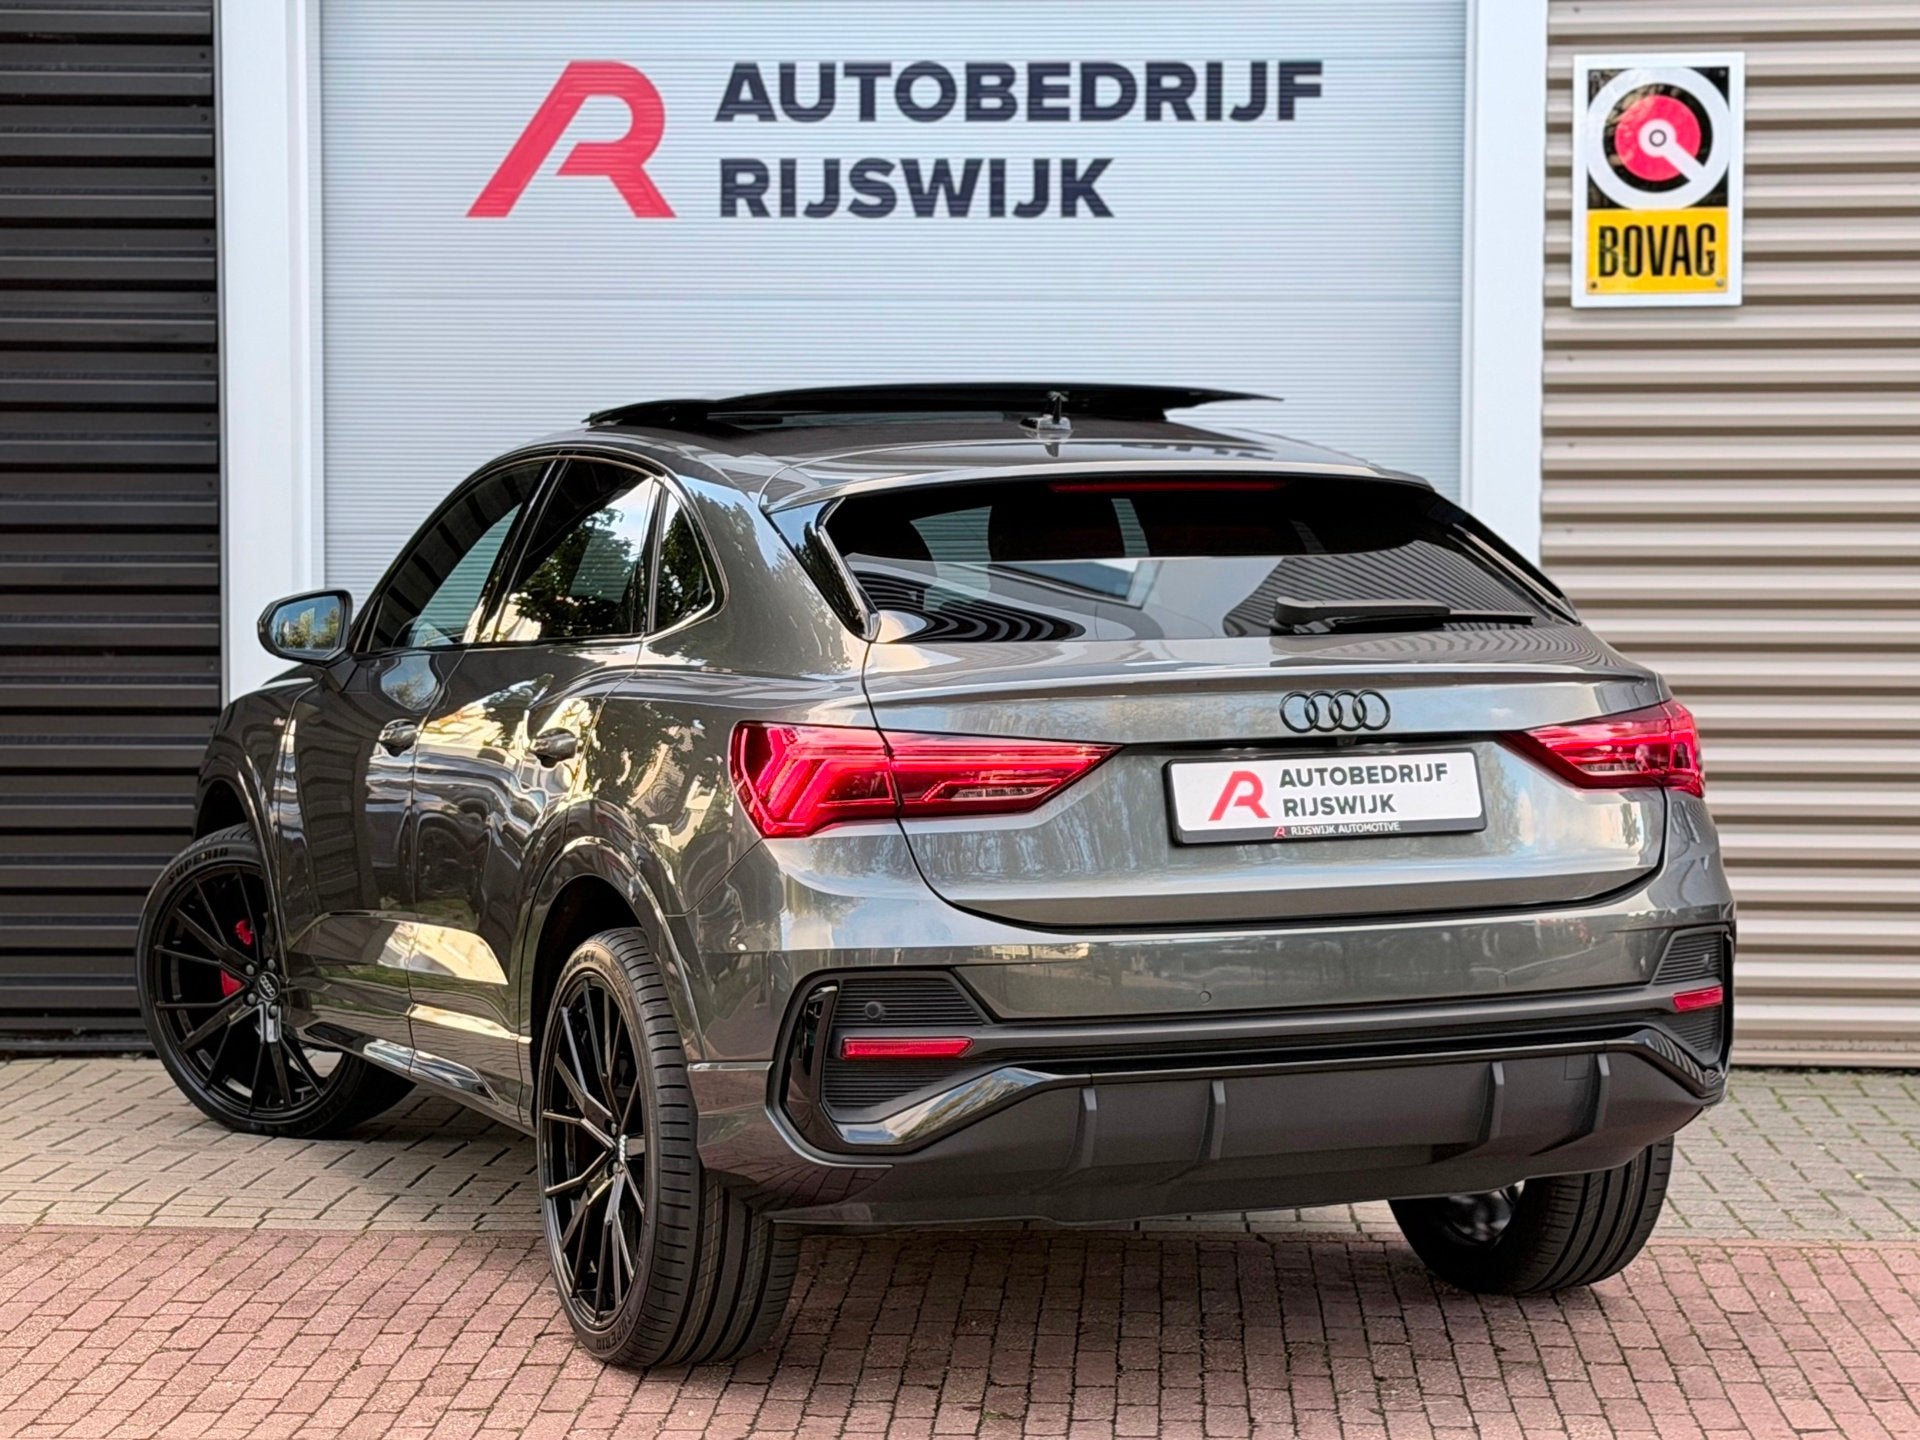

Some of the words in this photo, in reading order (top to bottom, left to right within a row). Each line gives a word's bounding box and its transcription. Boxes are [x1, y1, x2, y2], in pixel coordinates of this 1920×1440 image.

[714, 60, 1323, 123] AUTOBEDRIJF
[720, 157, 1115, 219] RIJSWIJK
[1598, 223, 1716, 278] BOVAG
[1279, 762, 1448, 788] AUTOBEDRIJF
[1283, 794, 1397, 818] RIJSWIJK
[1290, 824, 1337, 836] RIJSWIJK
[1338, 821, 1401, 835] AUTOMOTIVE
